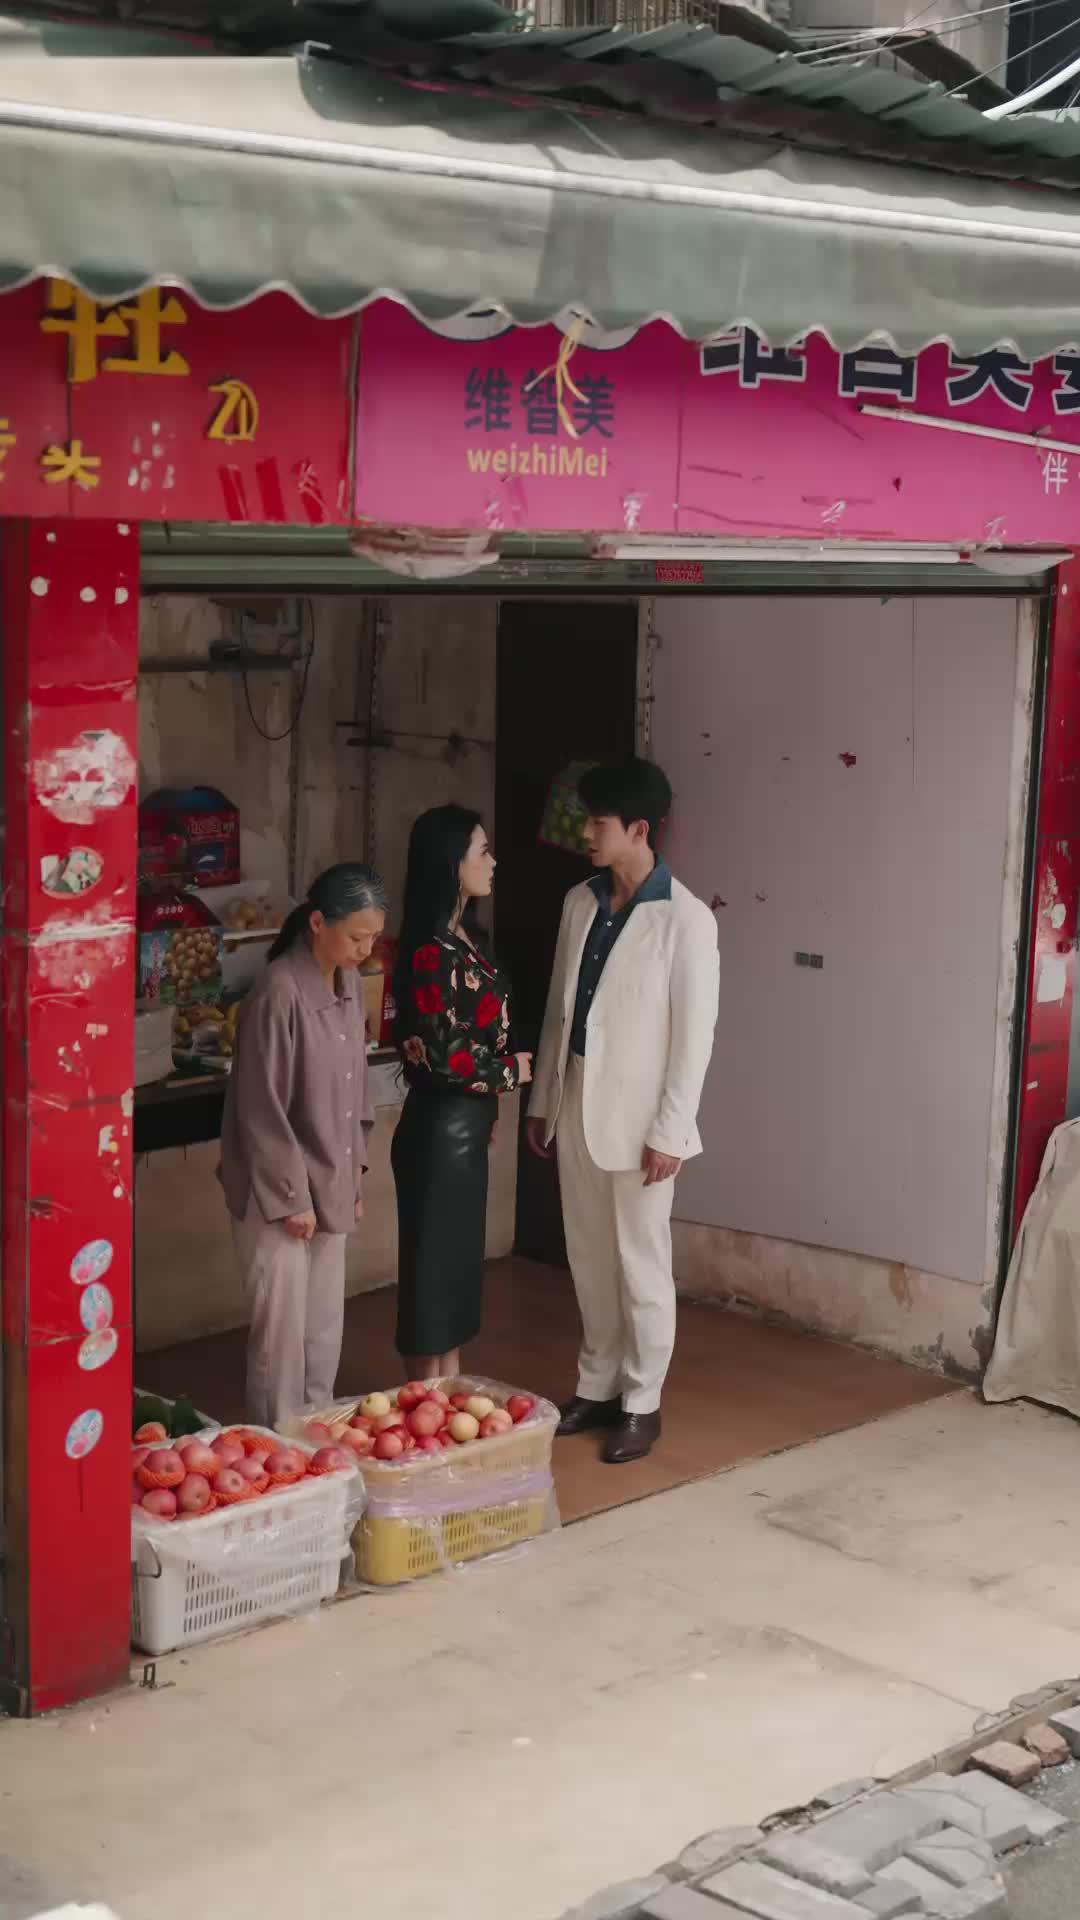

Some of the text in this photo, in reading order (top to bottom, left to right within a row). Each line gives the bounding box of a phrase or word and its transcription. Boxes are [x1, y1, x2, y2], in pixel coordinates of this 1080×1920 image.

[463, 366, 616, 438] 维智美
[466, 442, 608, 478] weizhiMei
